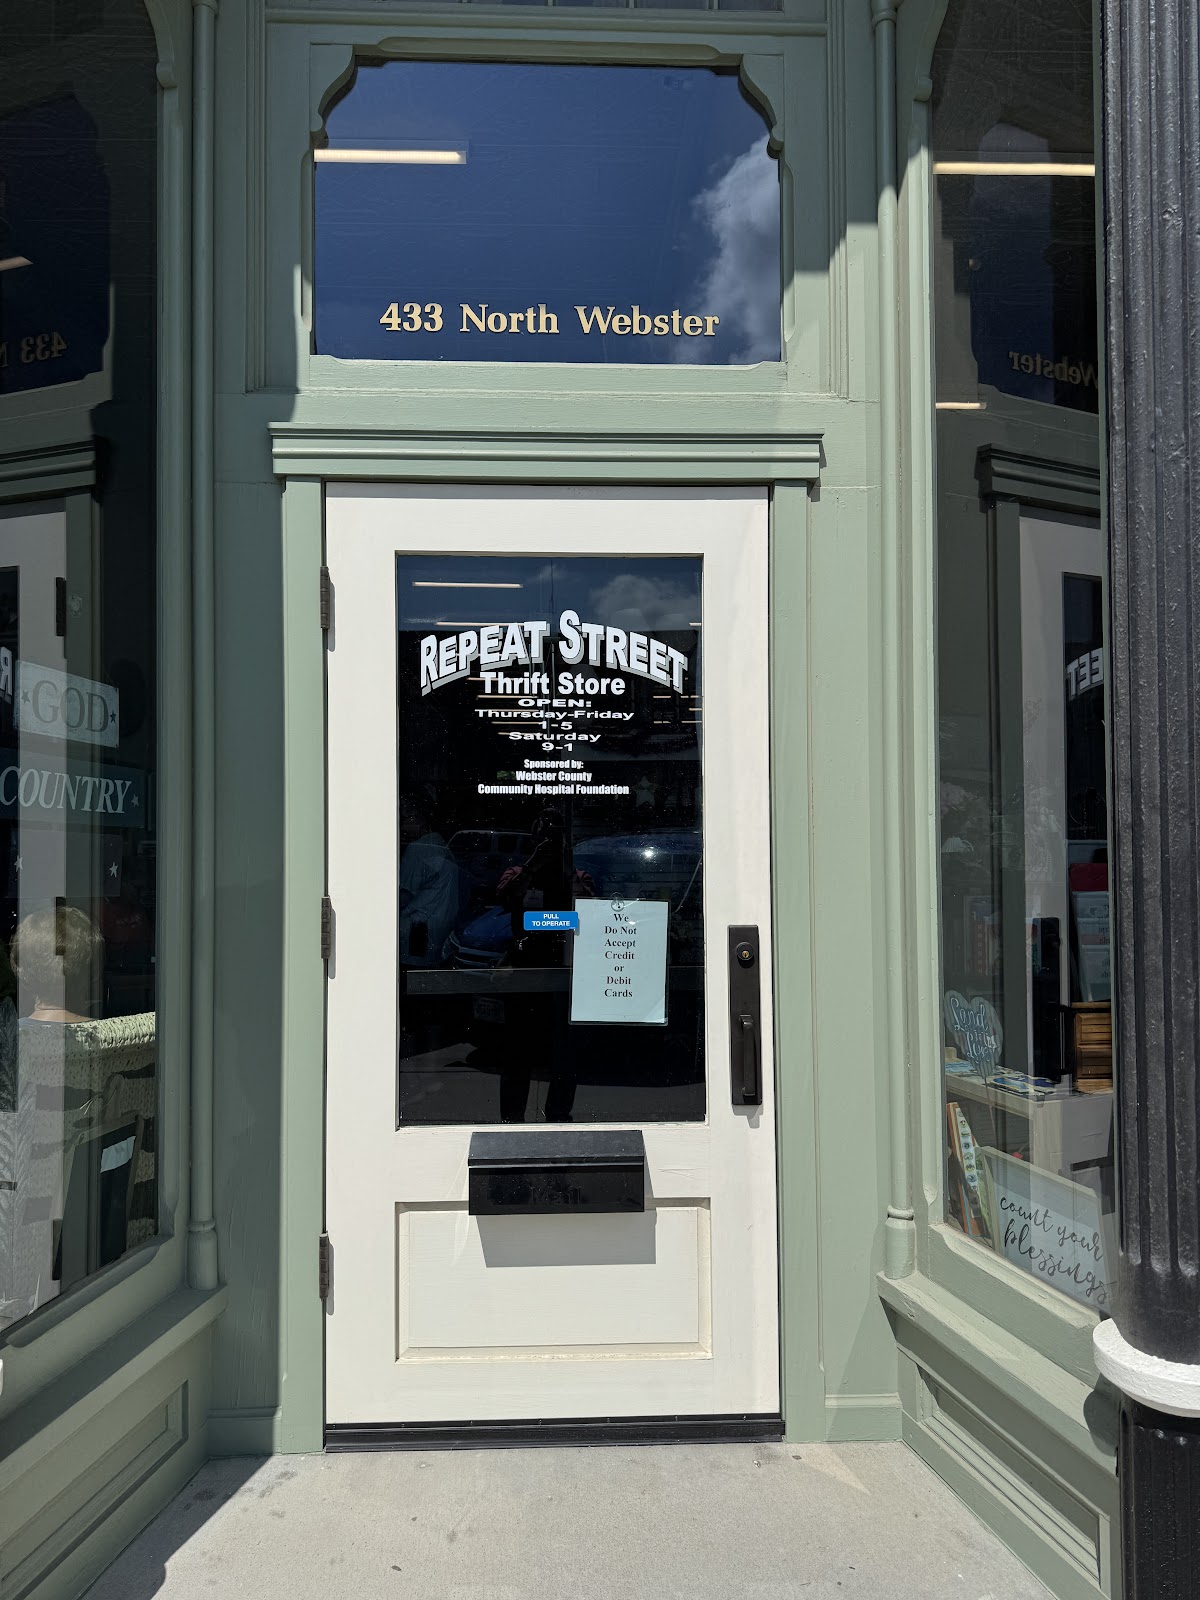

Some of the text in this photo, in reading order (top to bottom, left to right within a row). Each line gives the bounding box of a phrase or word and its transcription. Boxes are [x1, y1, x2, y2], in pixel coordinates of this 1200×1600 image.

[379, 302, 720, 336] 433 North Webster
[420, 610, 688, 696] REPEAT STREET
[480, 671, 626, 695] Thrift Store
[32, 679, 109, 733] GOD
[518, 699, 592, 708] OPEN:
[477, 710, 635, 721] Thursday-Friday
[538, 721, 573, 731] 1-5
[509, 732, 601, 743] Saturday
[541, 742, 573, 752] 9-1
[524, 759, 584, 770] Sponsored by:
[515, 770, 592, 783] Webster County
[0, 765, 133, 814] COUNTRY
[477, 783, 630, 796] Community Hospital Foundation
[613, 914, 629, 922] We
[604, 926, 637, 935] Do Not
[604, 938, 635, 947] Accept
[604, 951, 635, 960] Credit
[606, 976, 631, 985] Debit
[604, 989, 633, 998] Cards
[1000, 1196, 1104, 1262] count your
[1004, 1218, 1114, 1304] blessings
